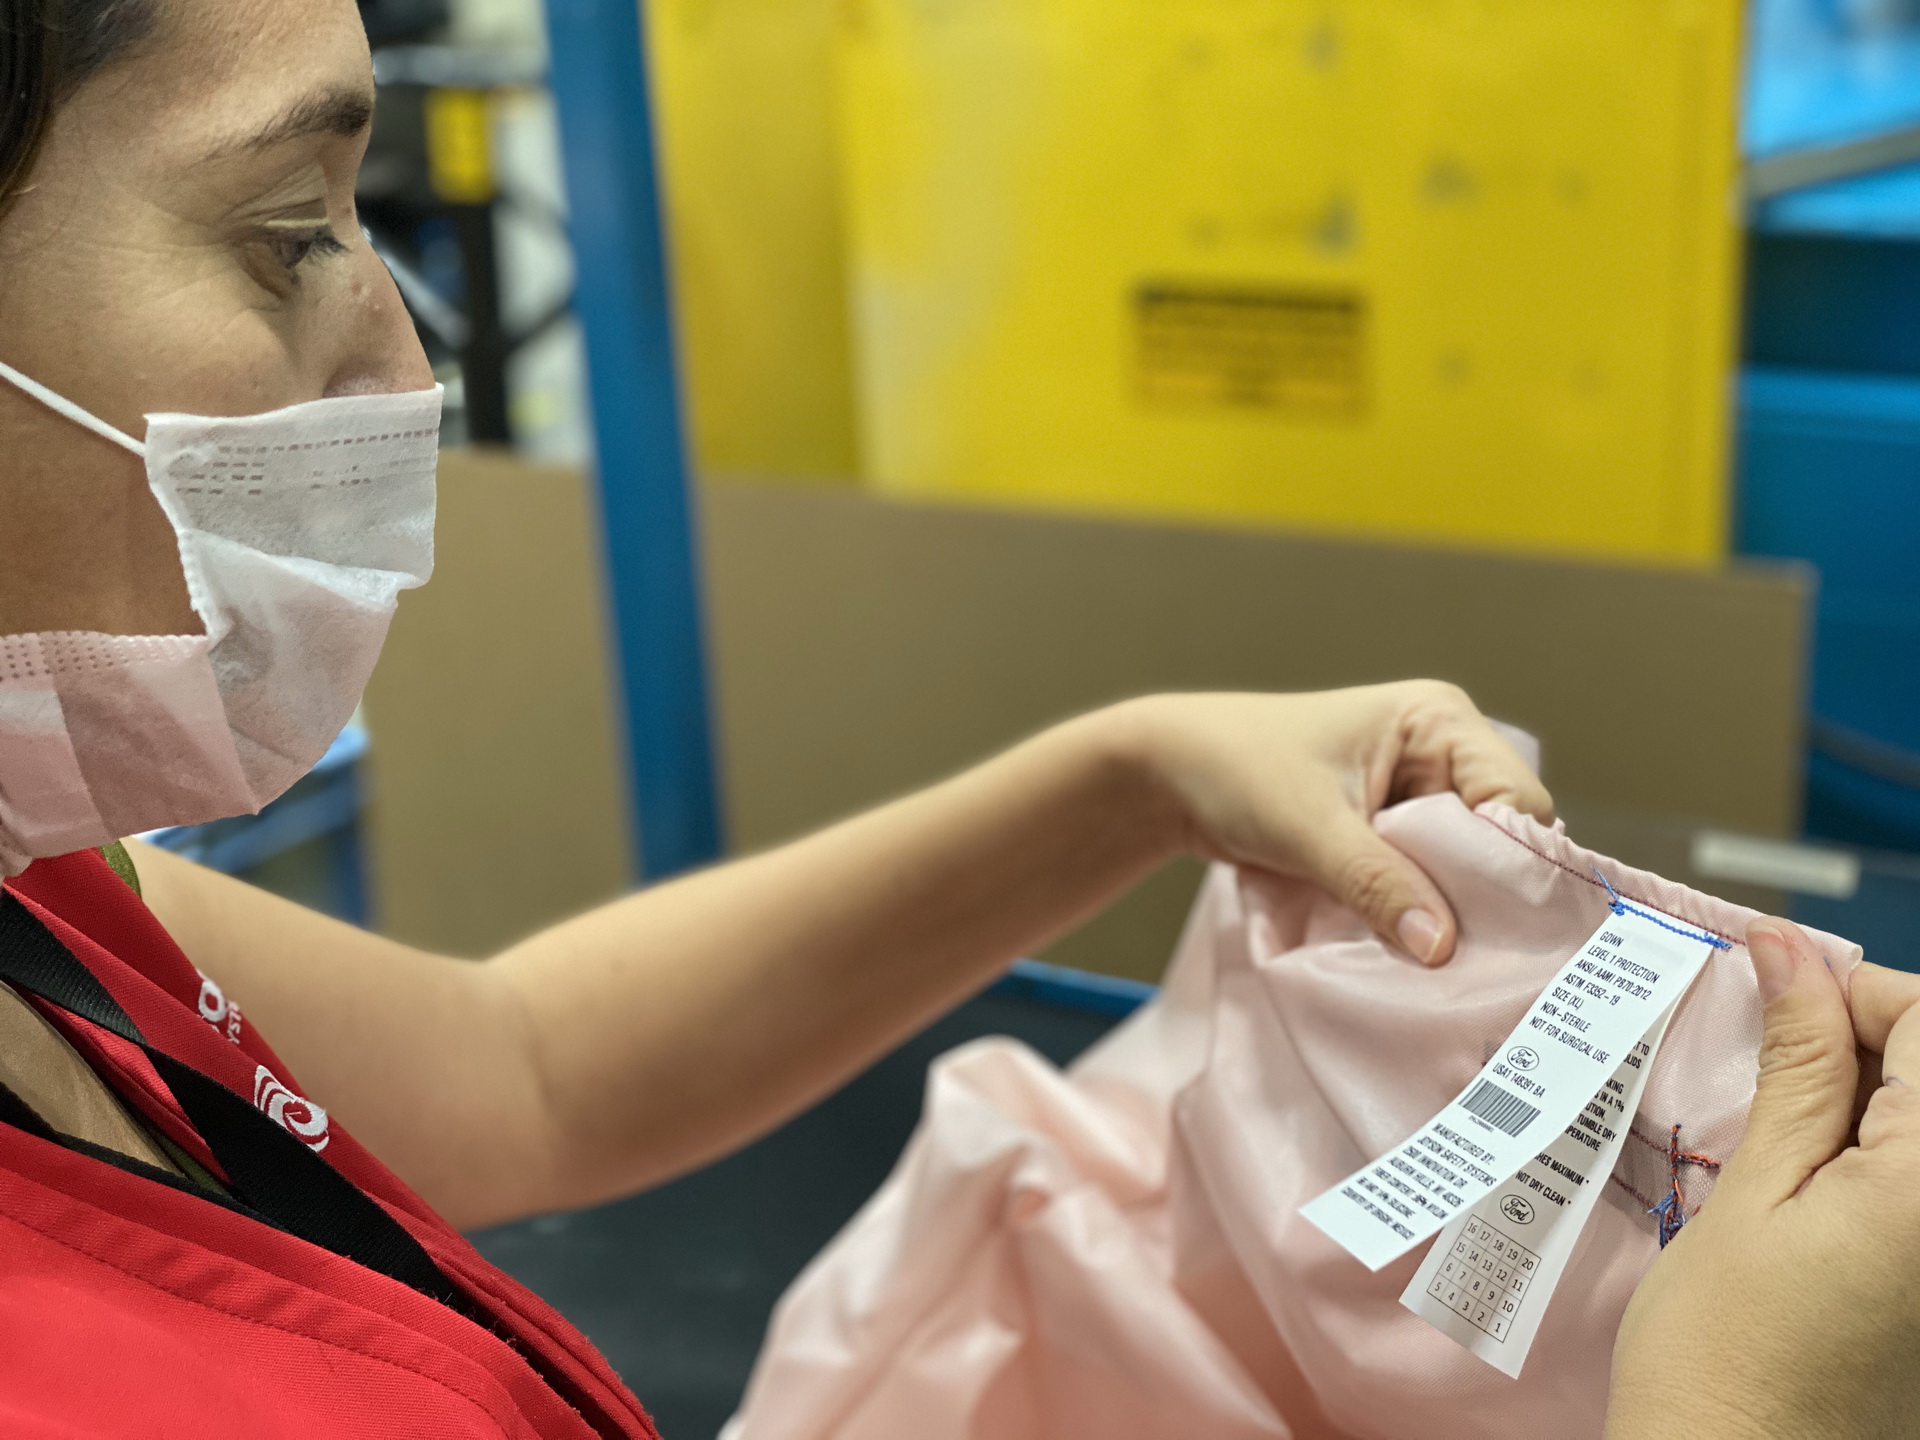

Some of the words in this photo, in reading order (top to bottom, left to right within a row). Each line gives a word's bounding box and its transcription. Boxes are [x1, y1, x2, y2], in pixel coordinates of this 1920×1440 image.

[1600, 931, 1624, 947] GOWN
[1588, 945, 1609, 962] LEVEL
[1609, 955, 1615, 963] 1
[1613, 956, 1660, 983] PROTECTION
[1563, 973, 1586, 987] ASTM
[1595, 968, 1615, 984] AAMI
[1615, 977, 1652, 1001] PB70:2012
[1552, 987, 1571, 1001] SIZE
[1568, 996, 1584, 1008] (XL)
[1529, 1016, 1546, 1031] NOT
[1544, 1023, 1560, 1037] FOR
[1559, 1030, 1593, 1055] SURGICAL
[1592, 1050, 1610, 1064] USE
[1641, 1044, 1649, 1056] TO
[1511, 1049, 1535, 1068] Ford
[1492, 1062, 1510, 1078] USA1
[1532, 1084, 1546, 1098] BA
[1606, 1078, 1624, 1094] AKING
[1585, 1102, 1606, 1121] UTION,
[1600, 1092, 1608, 1102] IN
[1607, 1096, 1613, 1106] A
[1614, 1099, 1624, 1112] 1%
[1432, 1123, 1485, 1158] MANUFACTURED
[1577, 1114, 1602, 1137] TUMBLE
[1601, 1126, 1617, 1142] DRY
[1440, 1149, 1465, 1168] SAFETY
[1464, 1165, 1497, 1187] SYSTEMS
[1550, 1160, 1584, 1185] MAXIMUM
[1529, 1177, 1544, 1193] DRY
[1543, 1187, 1566, 1206] CLEAN
[1504, 1198, 1530, 1221] Ford
[1467, 1223, 1477, 1233] 16
[1480, 1231, 1491, 1242] 17
[1493, 1239, 1504, 1251] 18
[1507, 1249, 1518, 1260] 19
[1522, 1258, 1534, 1271] 20
[1456, 1242, 1466, 1253] 15
[1469, 1250, 1478, 1262] 14
[1482, 1260, 1493, 1271] 13
[1496, 1269, 1507, 1281] 12
[1512, 1279, 1523, 1291] 11
[1446, 1263, 1452, 1272] 6
[1459, 1271, 1466, 1280] 7
[1473, 1282, 1480, 1290] 8
[1488, 1291, 1495, 1300] 9
[1502, 1301, 1514, 1313] 10
[1435, 1282, 1440, 1291] 5
[1448, 1292, 1454, 1301] 4
[1463, 1301, 1469, 1310] 3
[1478, 1312, 1484, 1321] 2
[1495, 1323, 1500, 1332] 1
